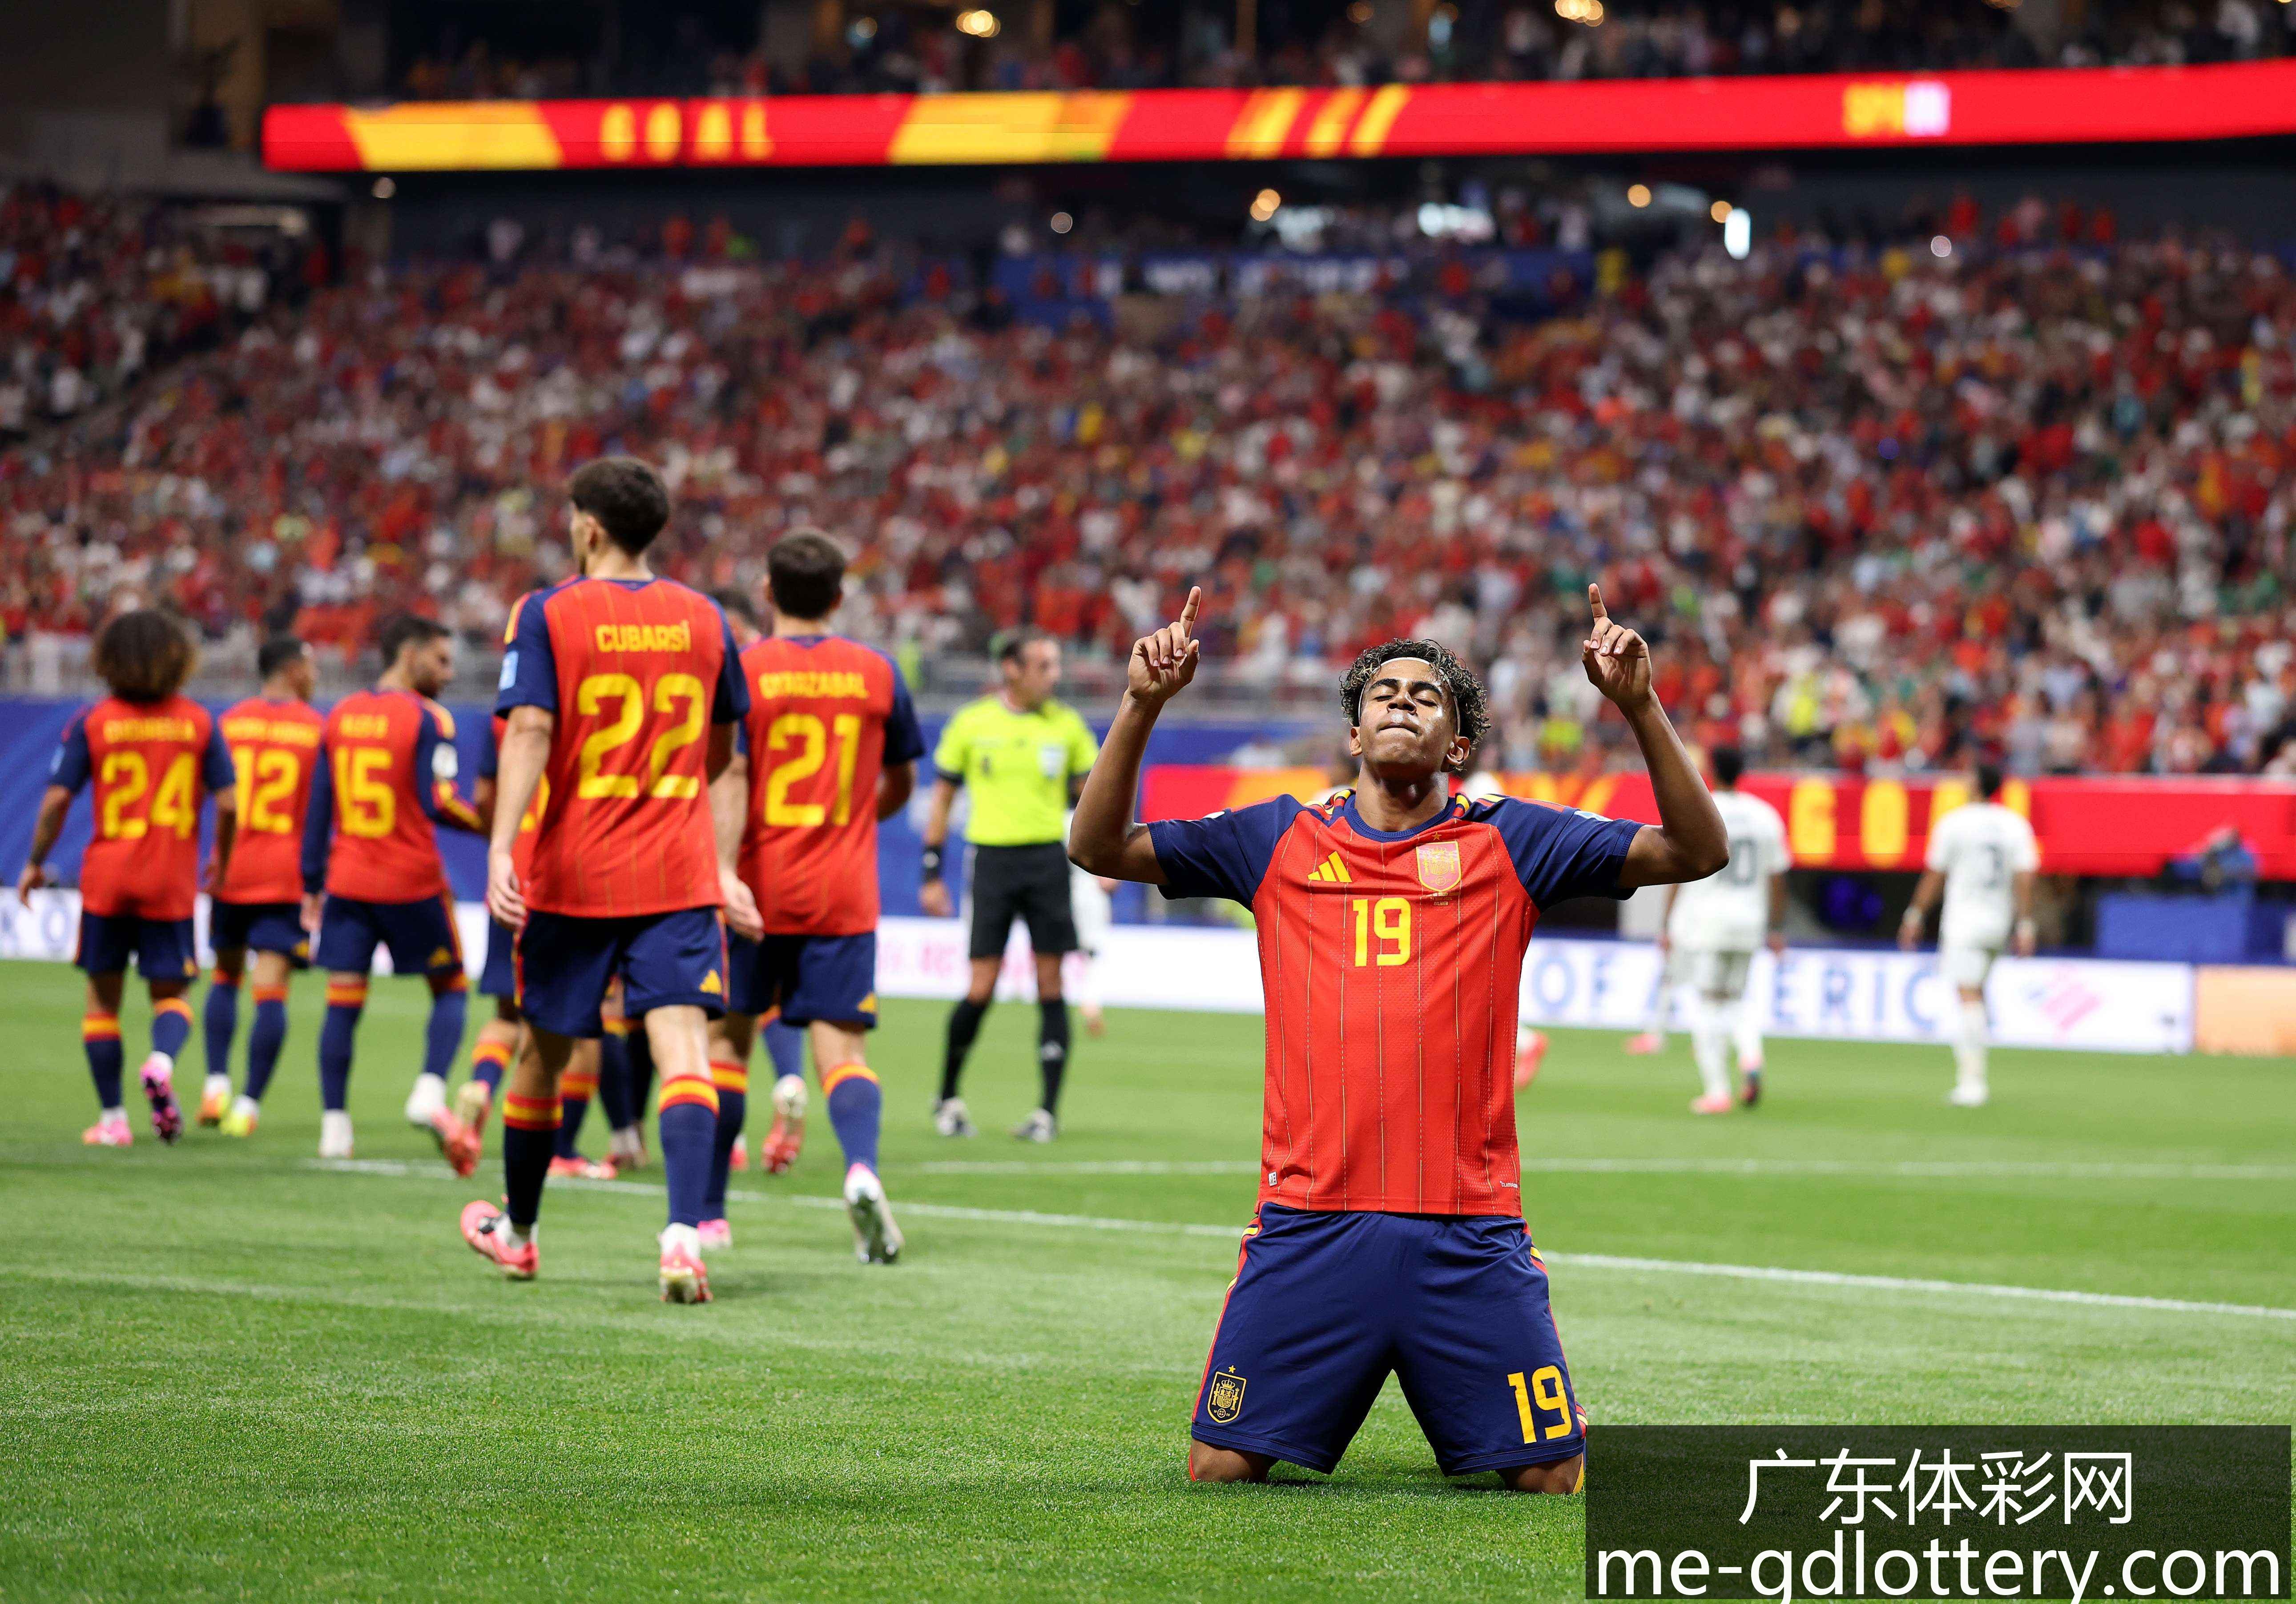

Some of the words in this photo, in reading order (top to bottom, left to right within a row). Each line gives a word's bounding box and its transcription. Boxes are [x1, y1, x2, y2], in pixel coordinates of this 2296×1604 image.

[595, 619, 691, 652] CUBARSÍ
[578, 673, 705, 800] 22
[764, 713, 861, 828] 21
[102, 751, 196, 839] 24
[234, 746, 299, 834] 12
[334, 746, 395, 837] 15
[1352, 897, 1411, 967] 19
[1533, 953, 1616, 1016] OF
[1507, 1366, 1572, 1444] 19
